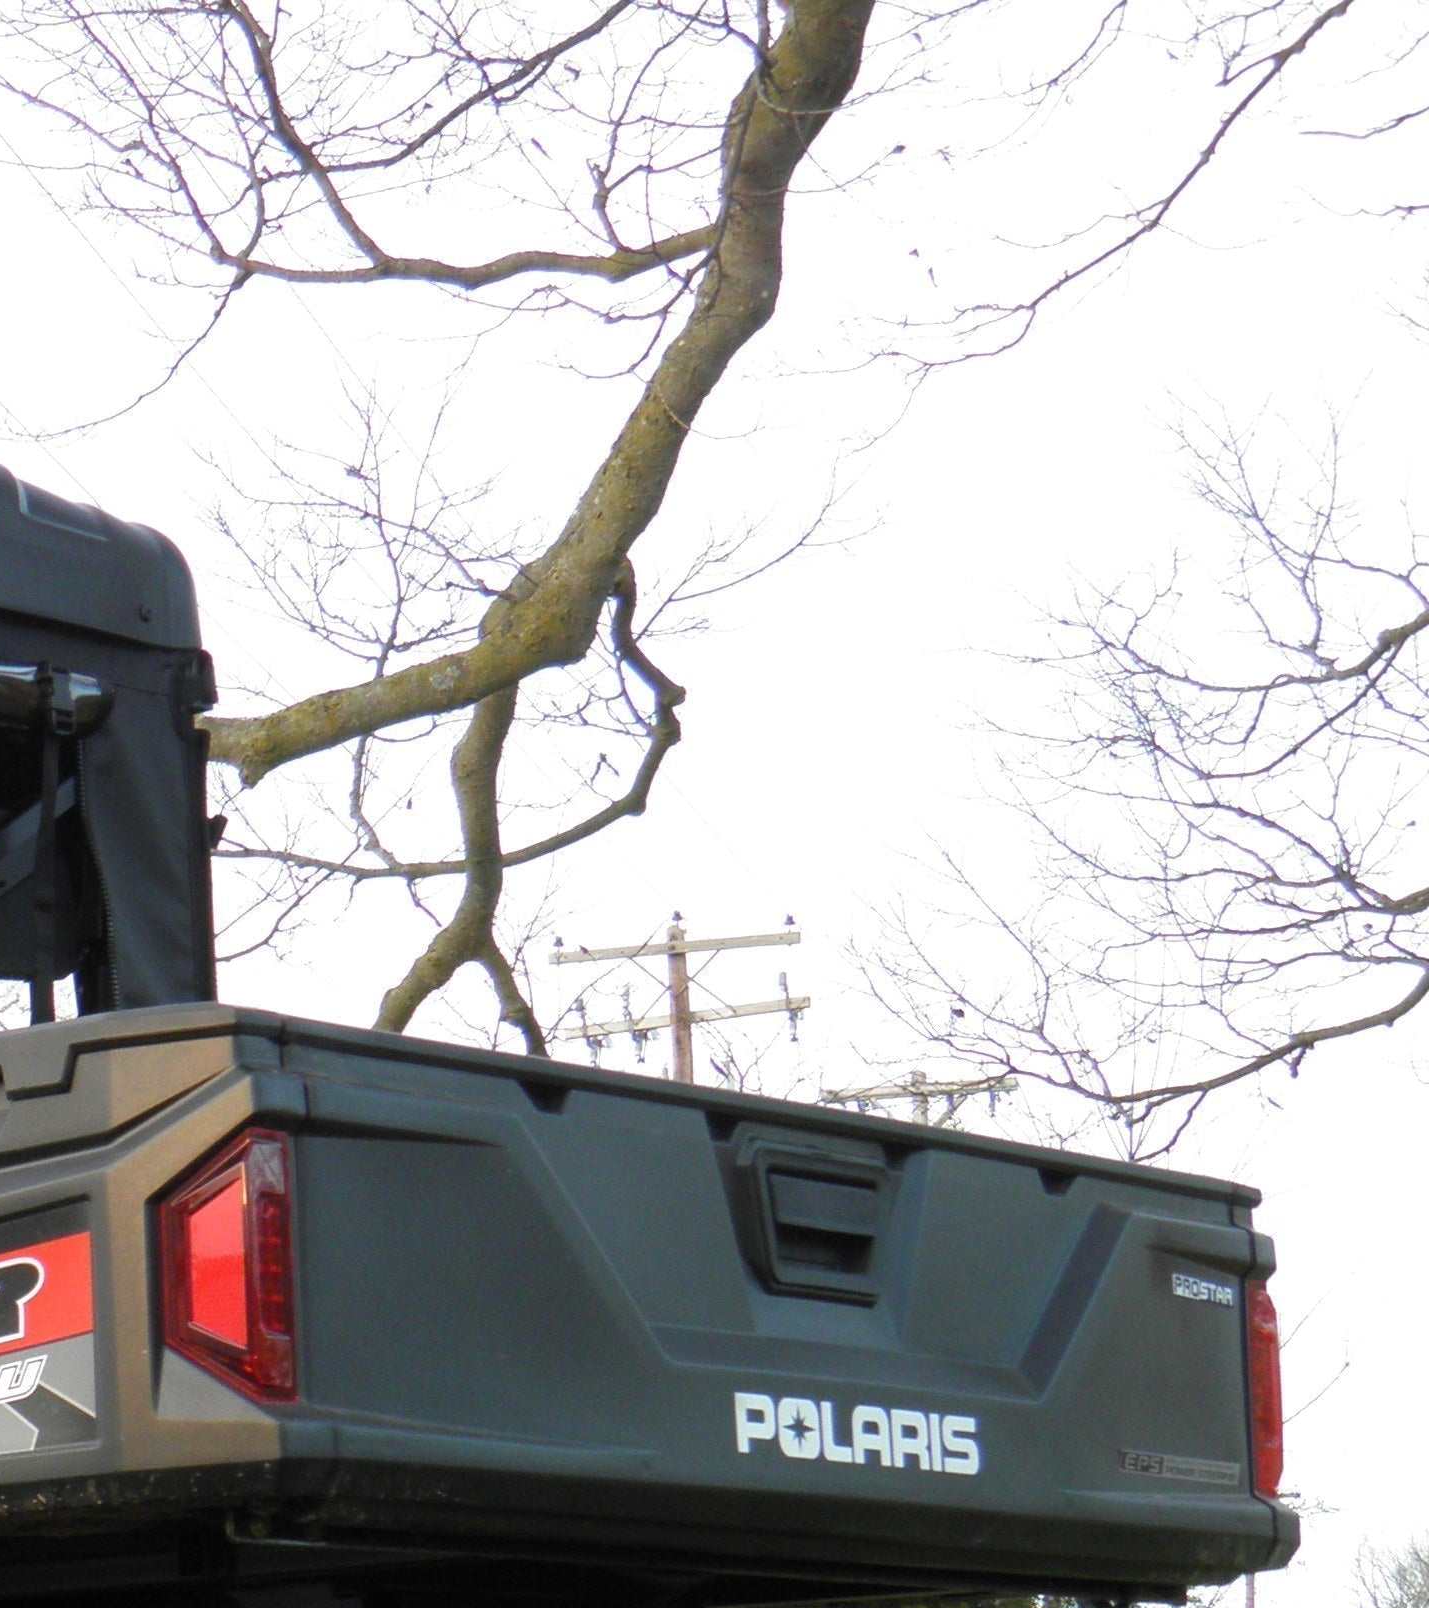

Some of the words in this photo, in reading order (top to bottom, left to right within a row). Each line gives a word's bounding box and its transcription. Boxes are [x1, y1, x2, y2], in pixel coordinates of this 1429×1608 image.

[1172, 1273, 1233, 1306] PROSTAR
[734, 1392, 980, 1475] POLARIS
[1124, 1452, 1162, 1475] EPS
